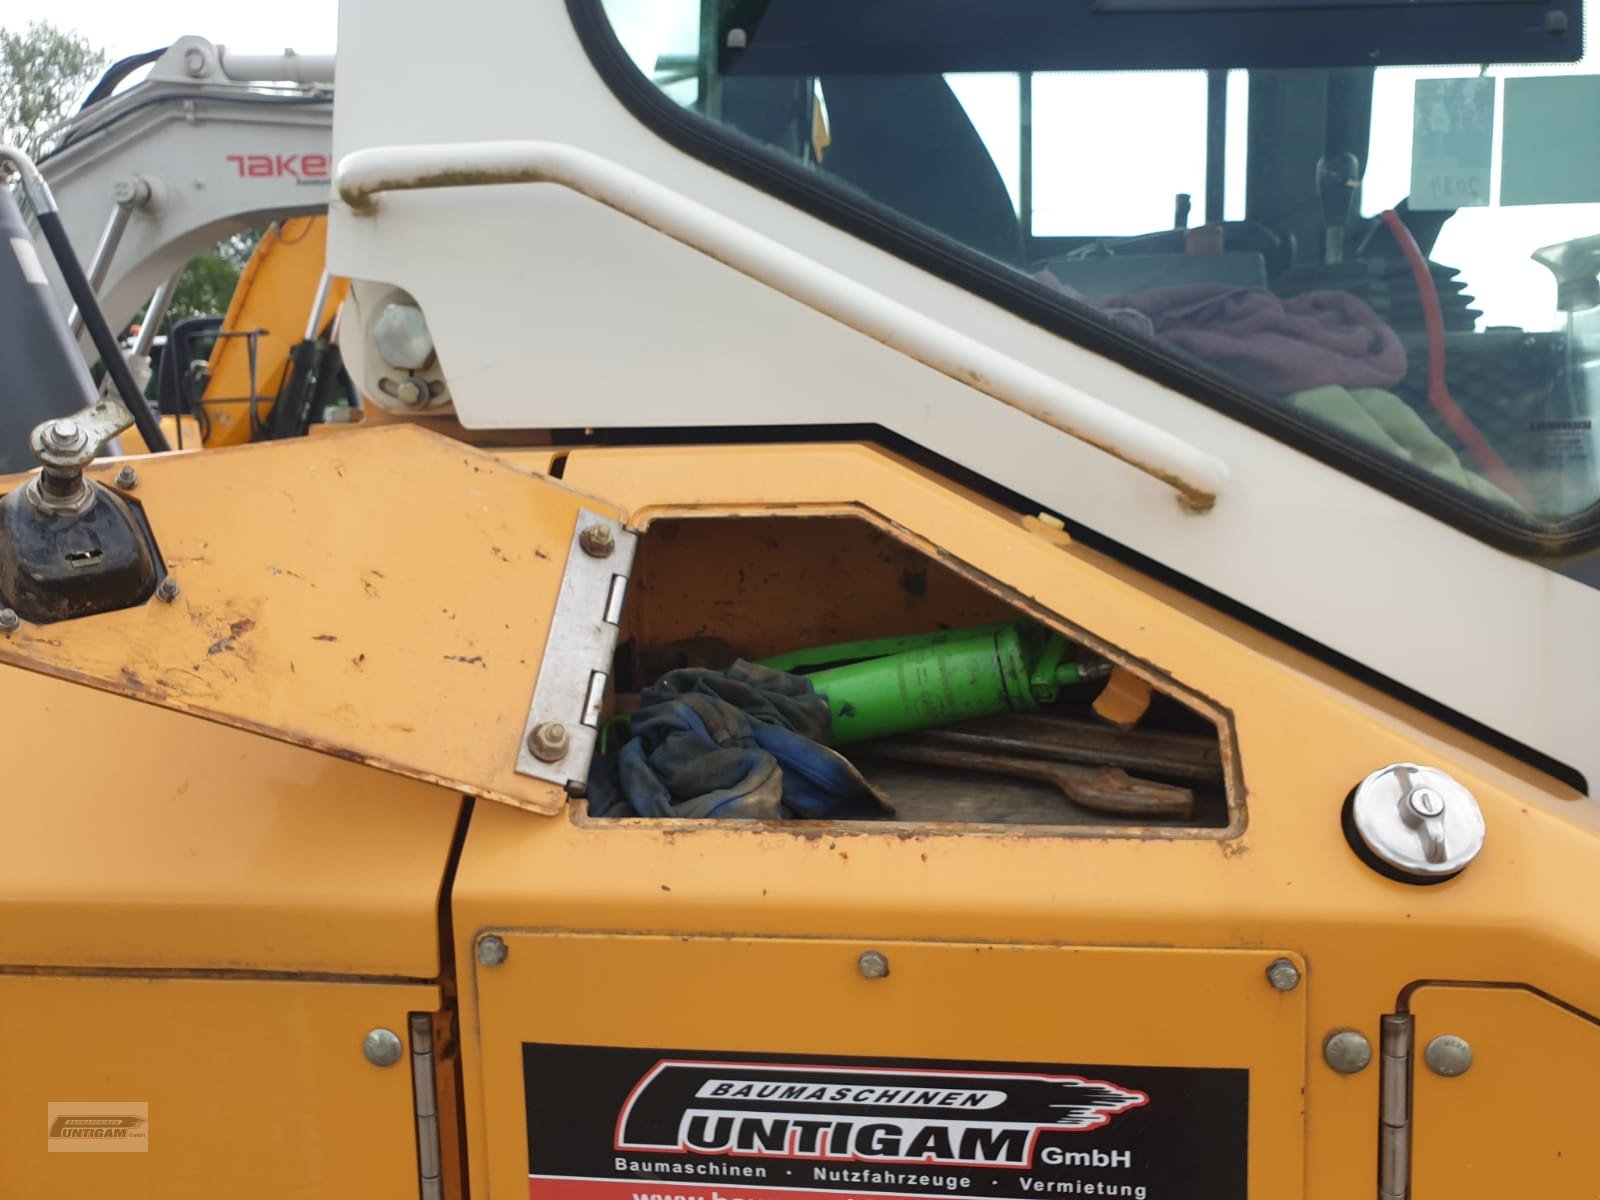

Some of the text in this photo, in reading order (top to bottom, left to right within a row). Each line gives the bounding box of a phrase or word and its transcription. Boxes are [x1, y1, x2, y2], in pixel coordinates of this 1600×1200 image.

[711, 1082, 989, 1108] BAUMASCHINEN
[1040, 1146, 1132, 1169] GmbH
[614, 1157, 1148, 1200] Baumaschinen Nutzfahrzeuge Vermietung
